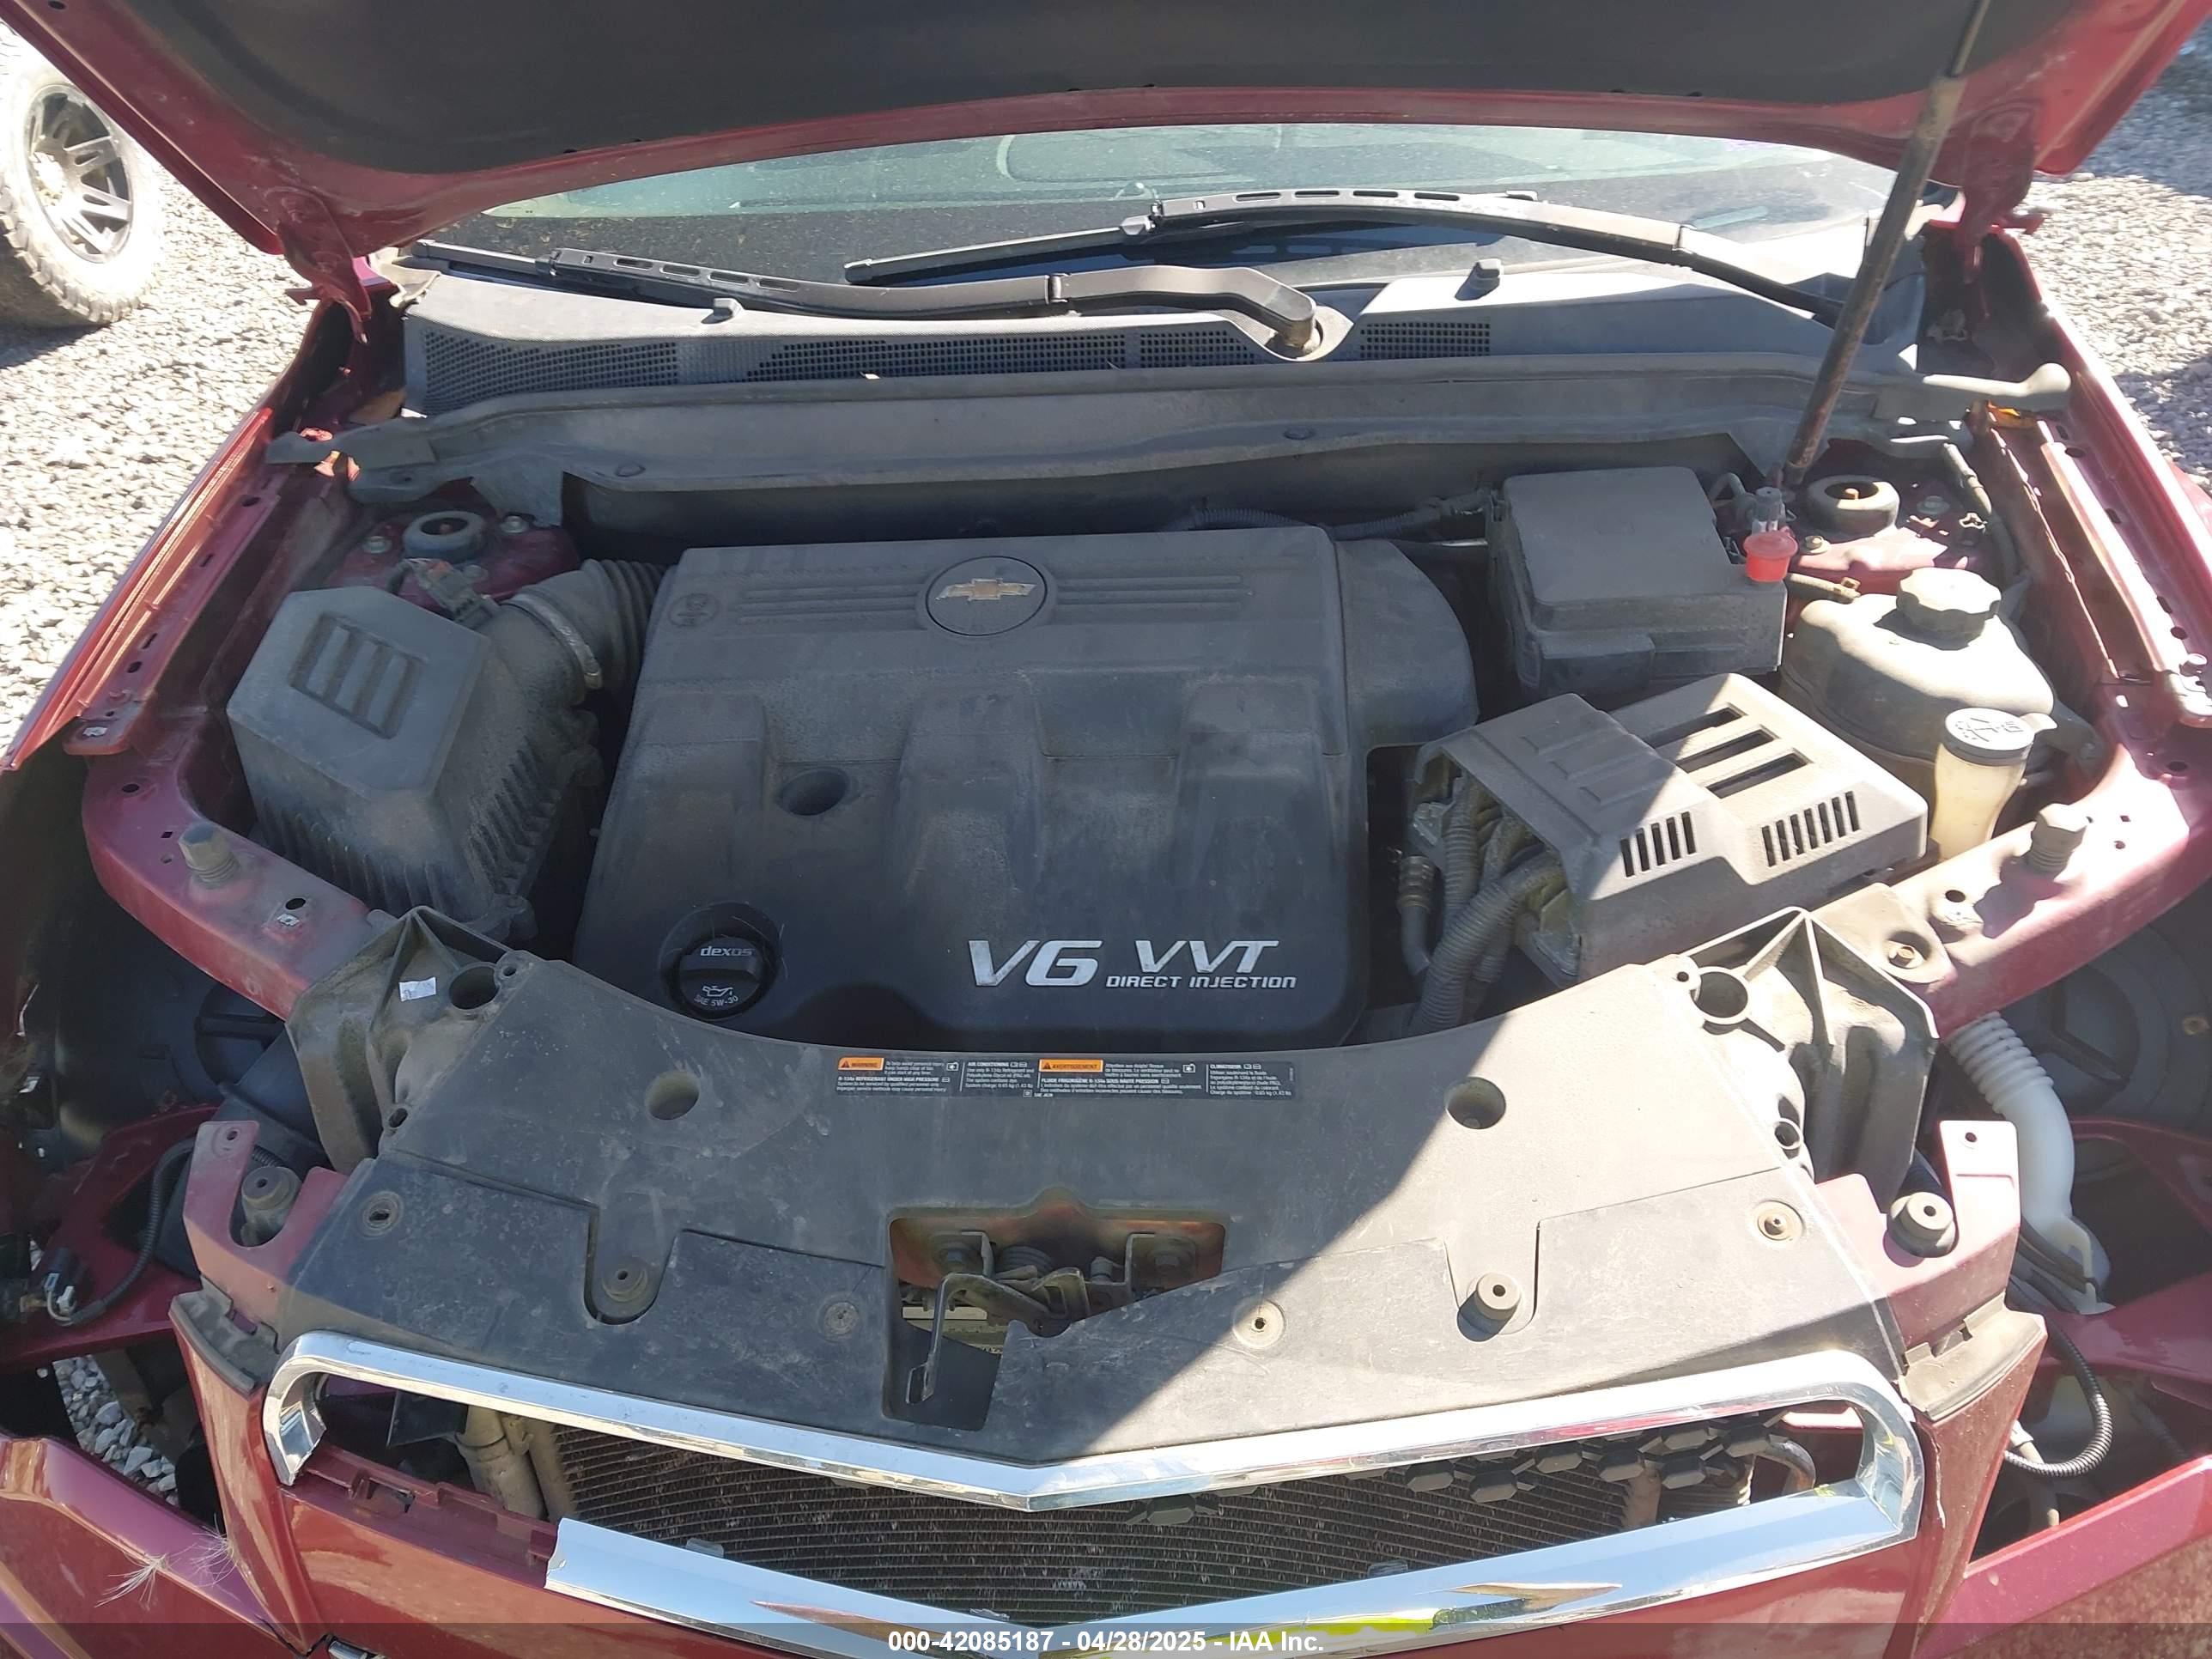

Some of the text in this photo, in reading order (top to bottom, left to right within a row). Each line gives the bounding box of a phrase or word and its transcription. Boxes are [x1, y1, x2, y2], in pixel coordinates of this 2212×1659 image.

[700, 945, 754, 957] dexos
[1135, 940, 1279, 973] VVT
[968, 939, 1103, 987] V6
[1105, 975, 1297, 989] DIRECT INJECTION
[694, 994, 739, 1006] SAE 5W-30
